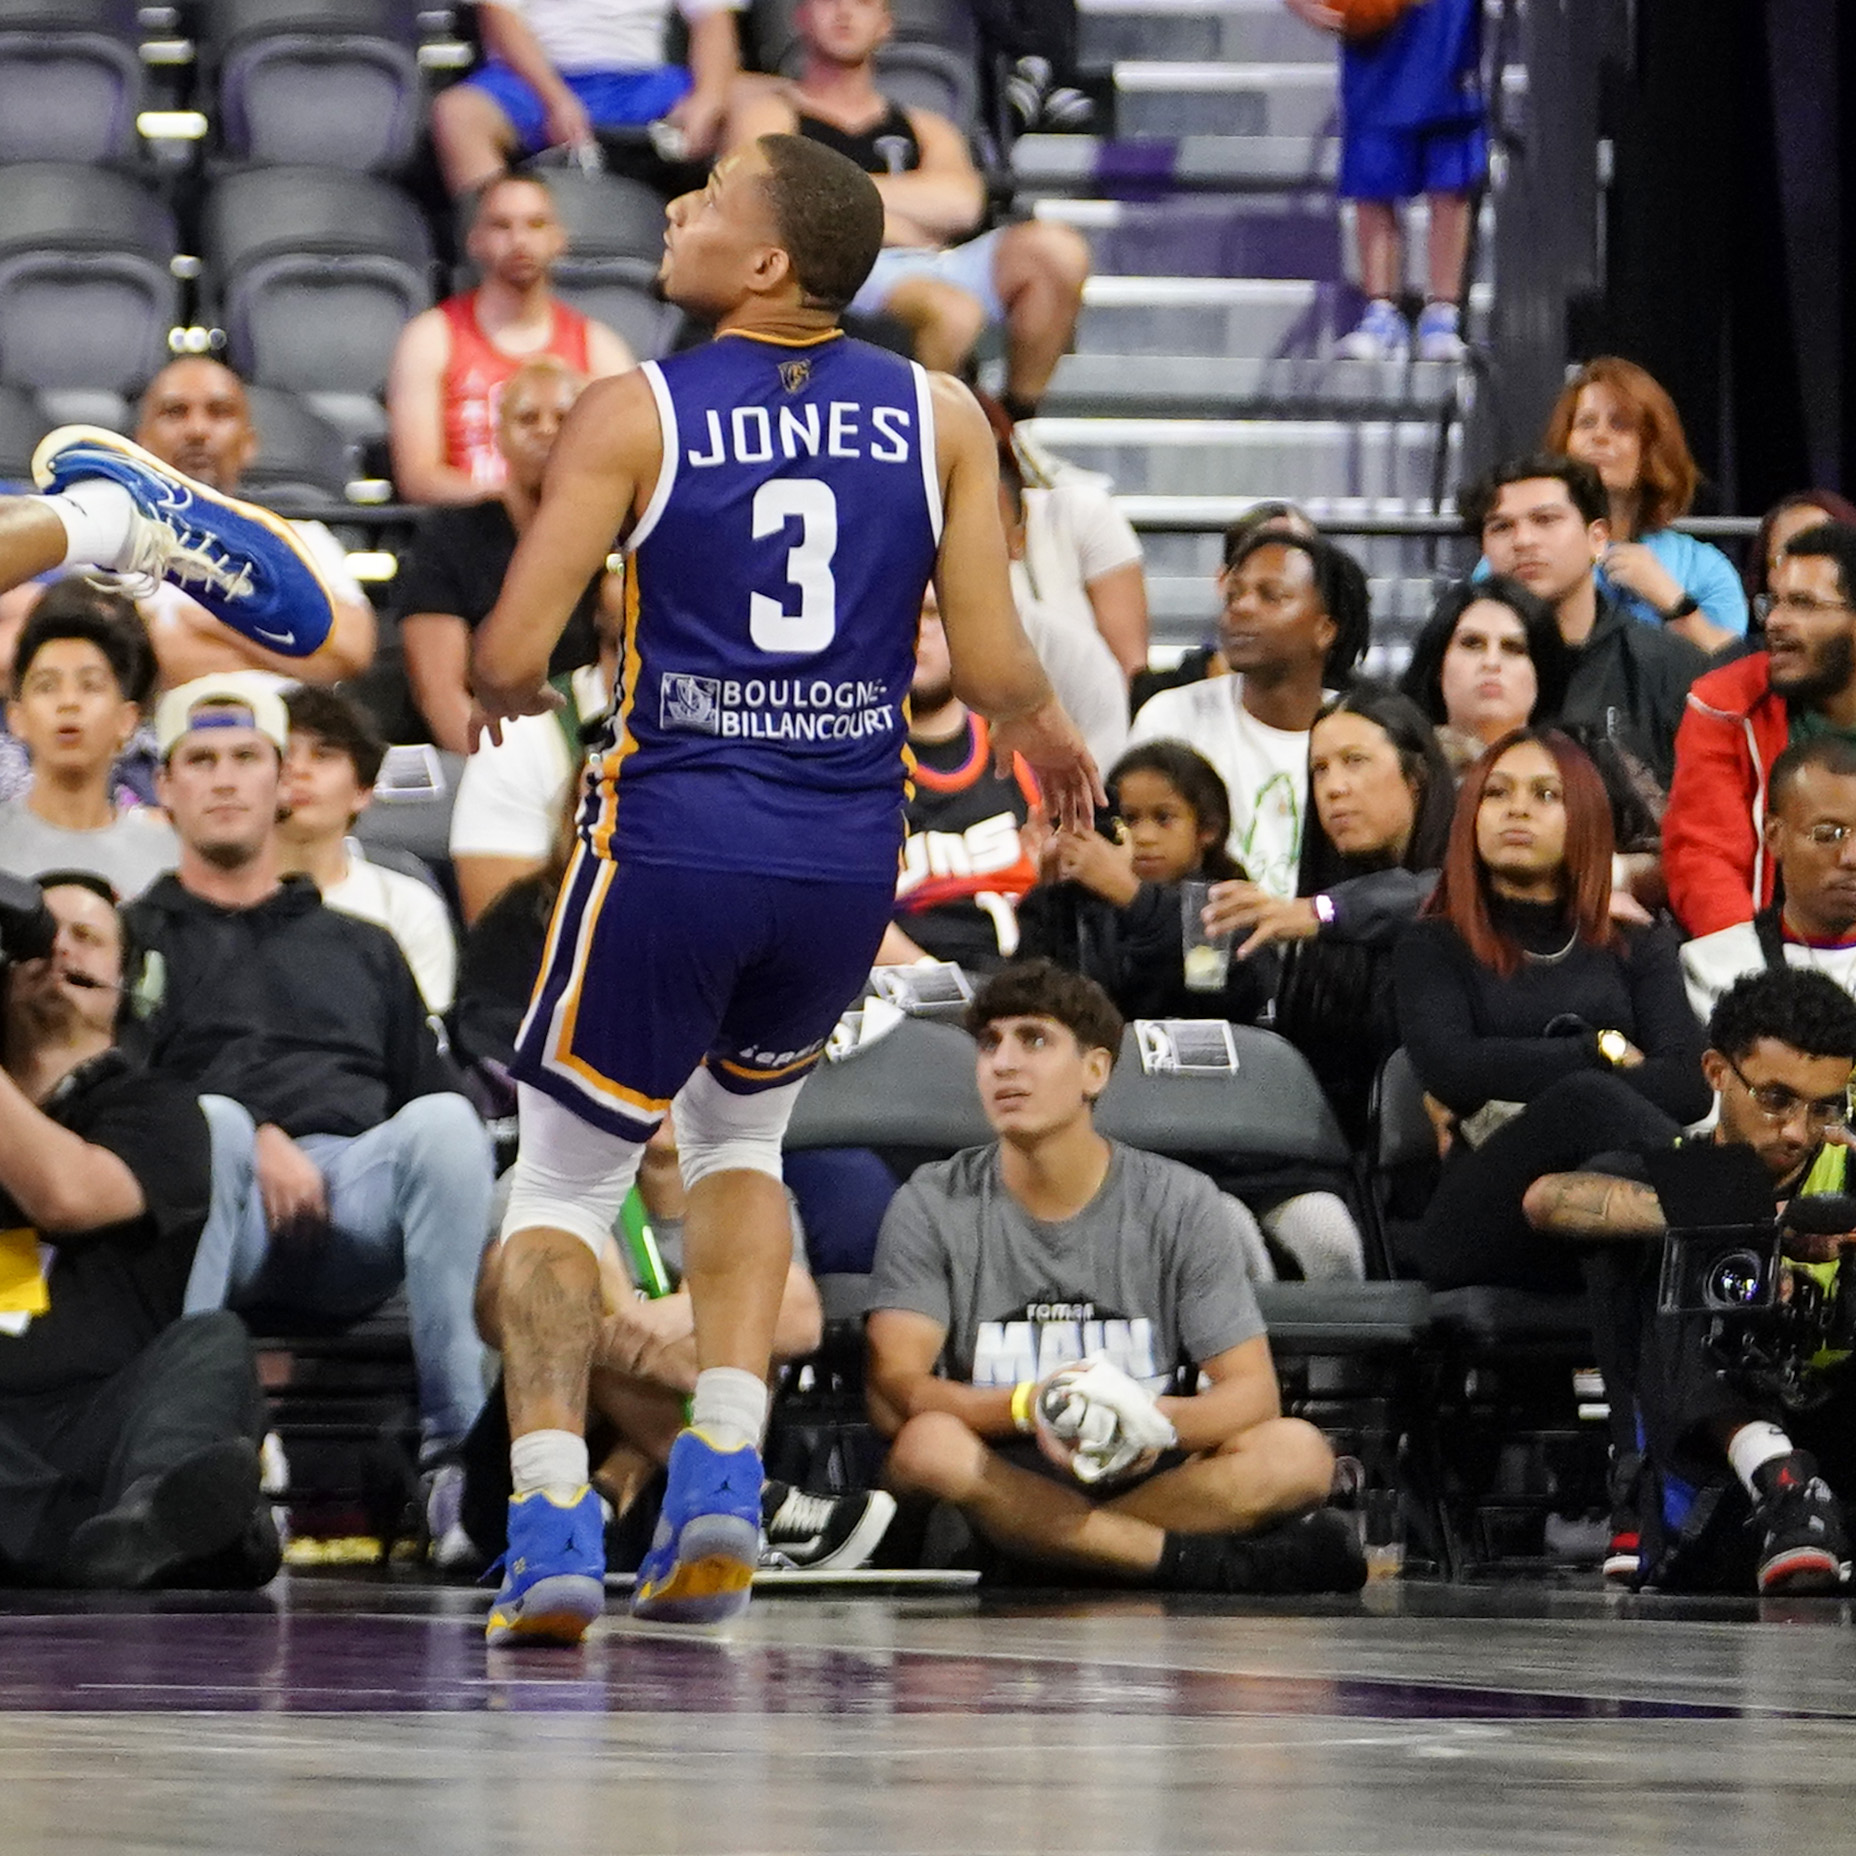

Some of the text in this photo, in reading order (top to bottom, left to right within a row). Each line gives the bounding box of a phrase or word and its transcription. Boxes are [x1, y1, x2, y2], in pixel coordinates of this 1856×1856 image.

[688, 402, 910, 466] JONES
[750, 479, 837, 652] 3
[721, 704, 894, 741] BILLANCOURT
